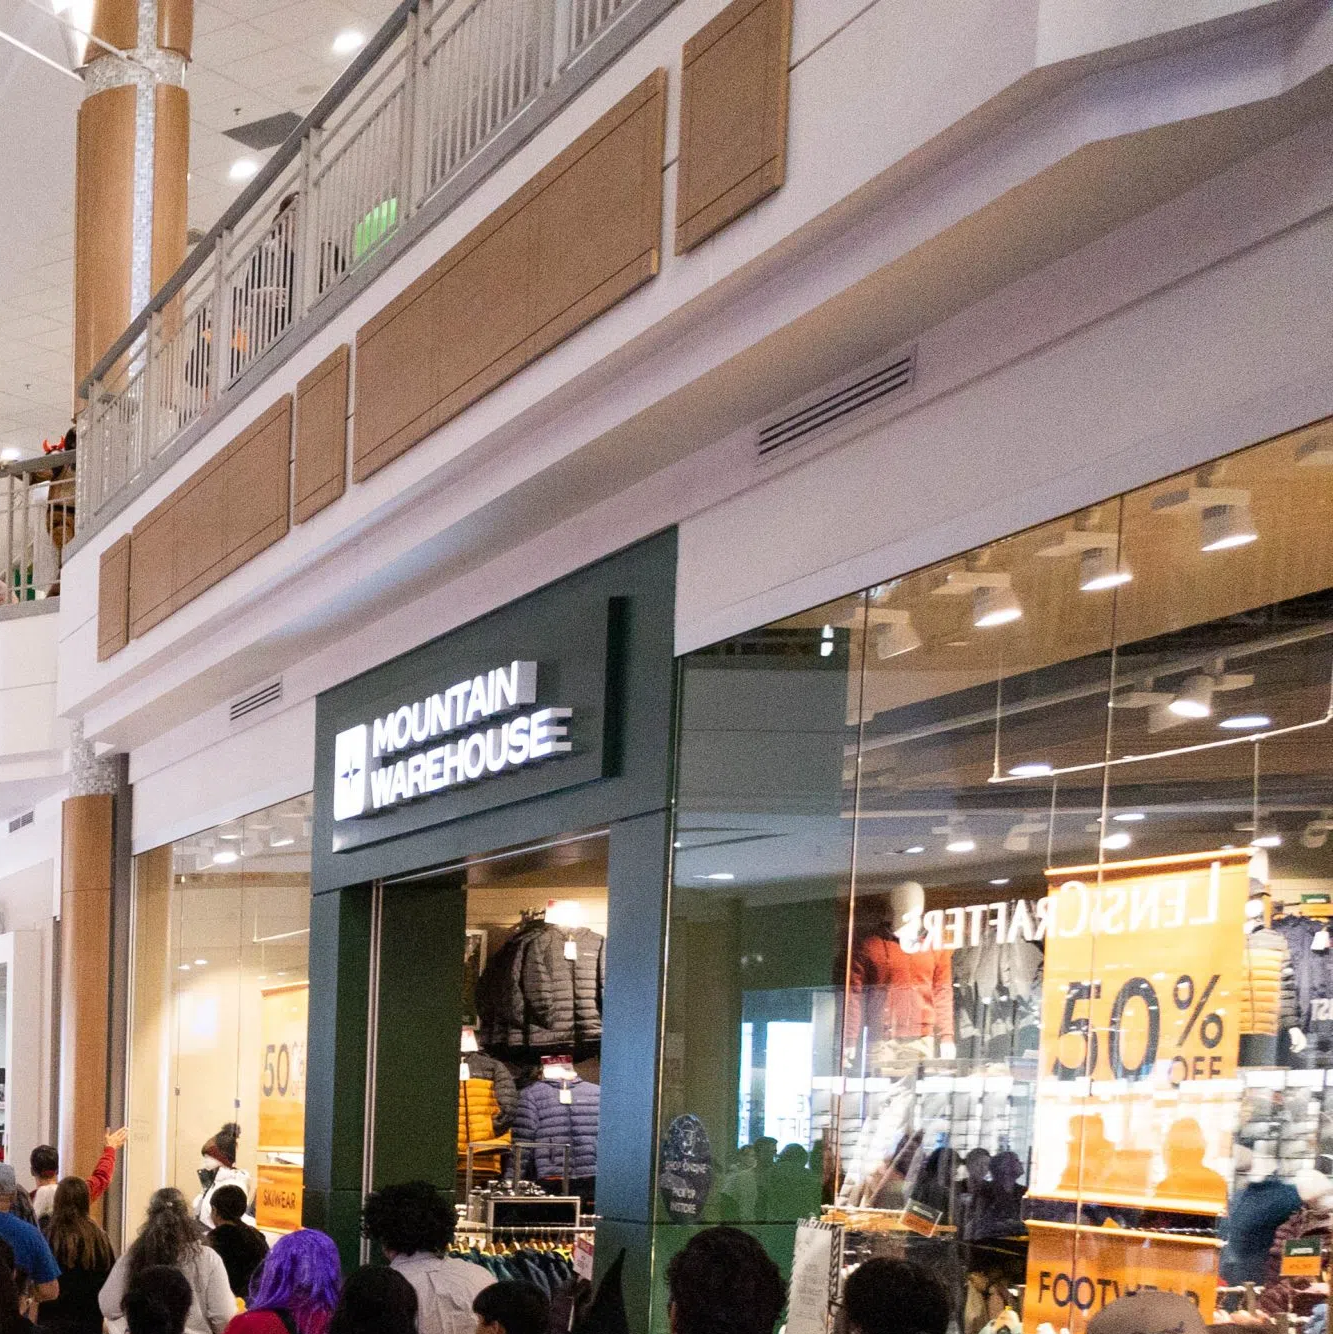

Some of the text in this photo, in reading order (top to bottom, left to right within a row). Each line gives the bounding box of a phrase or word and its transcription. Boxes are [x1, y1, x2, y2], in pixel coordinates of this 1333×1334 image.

[371, 708, 559, 808] WAREHOUSE
[373, 660, 523, 757] MOUNTAIN
[1052, 973, 1224, 1081] 50%
